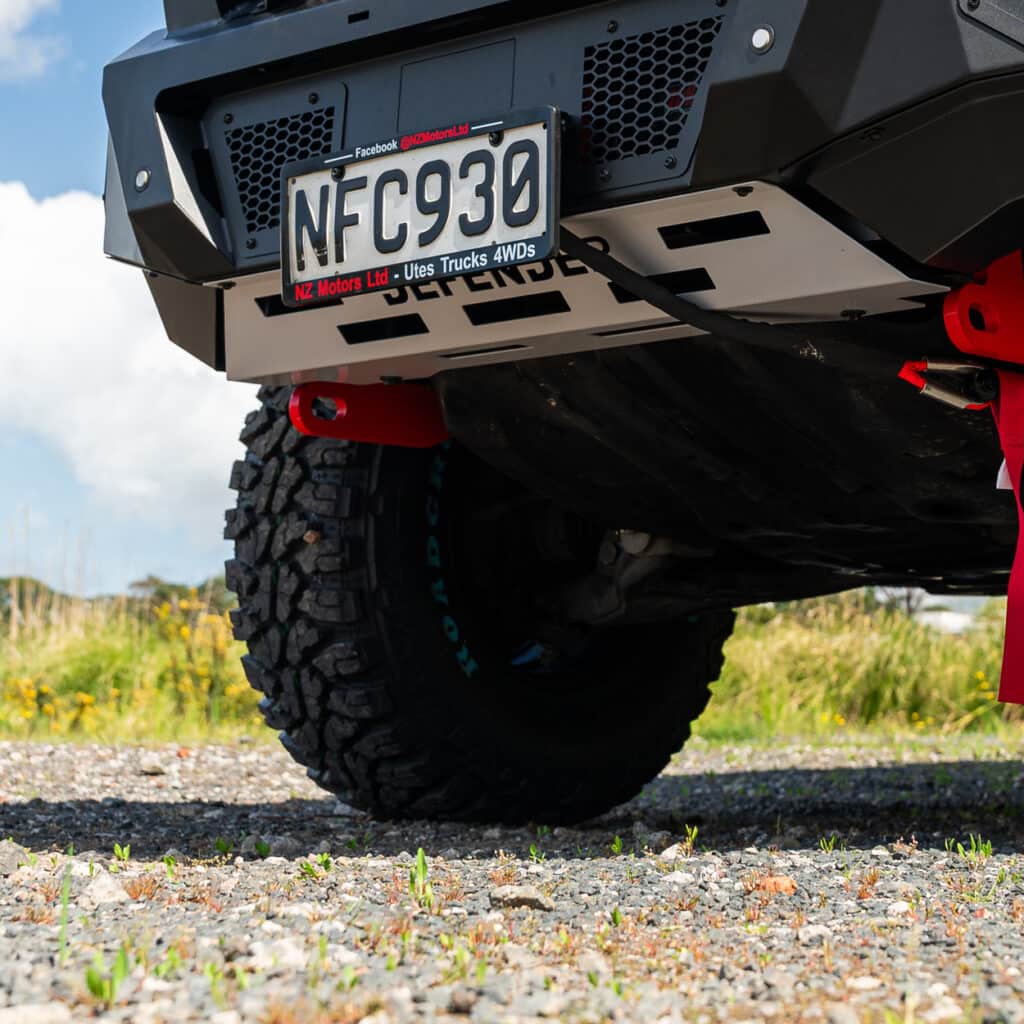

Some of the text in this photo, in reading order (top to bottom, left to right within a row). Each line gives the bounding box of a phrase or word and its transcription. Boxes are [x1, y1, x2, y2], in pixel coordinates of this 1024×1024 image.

[355, 123, 469, 158] Facebook @NZMotorsLtd
[294, 138, 541, 272] NFC930
[295, 282, 313, 301] NZ
[317, 276, 362, 297] Motors
[367, 267, 389, 288] Ltd
[404, 263, 434, 281] Utes
[440, 251, 488, 273] Trucks
[493, 242, 536, 264] 4WDs
